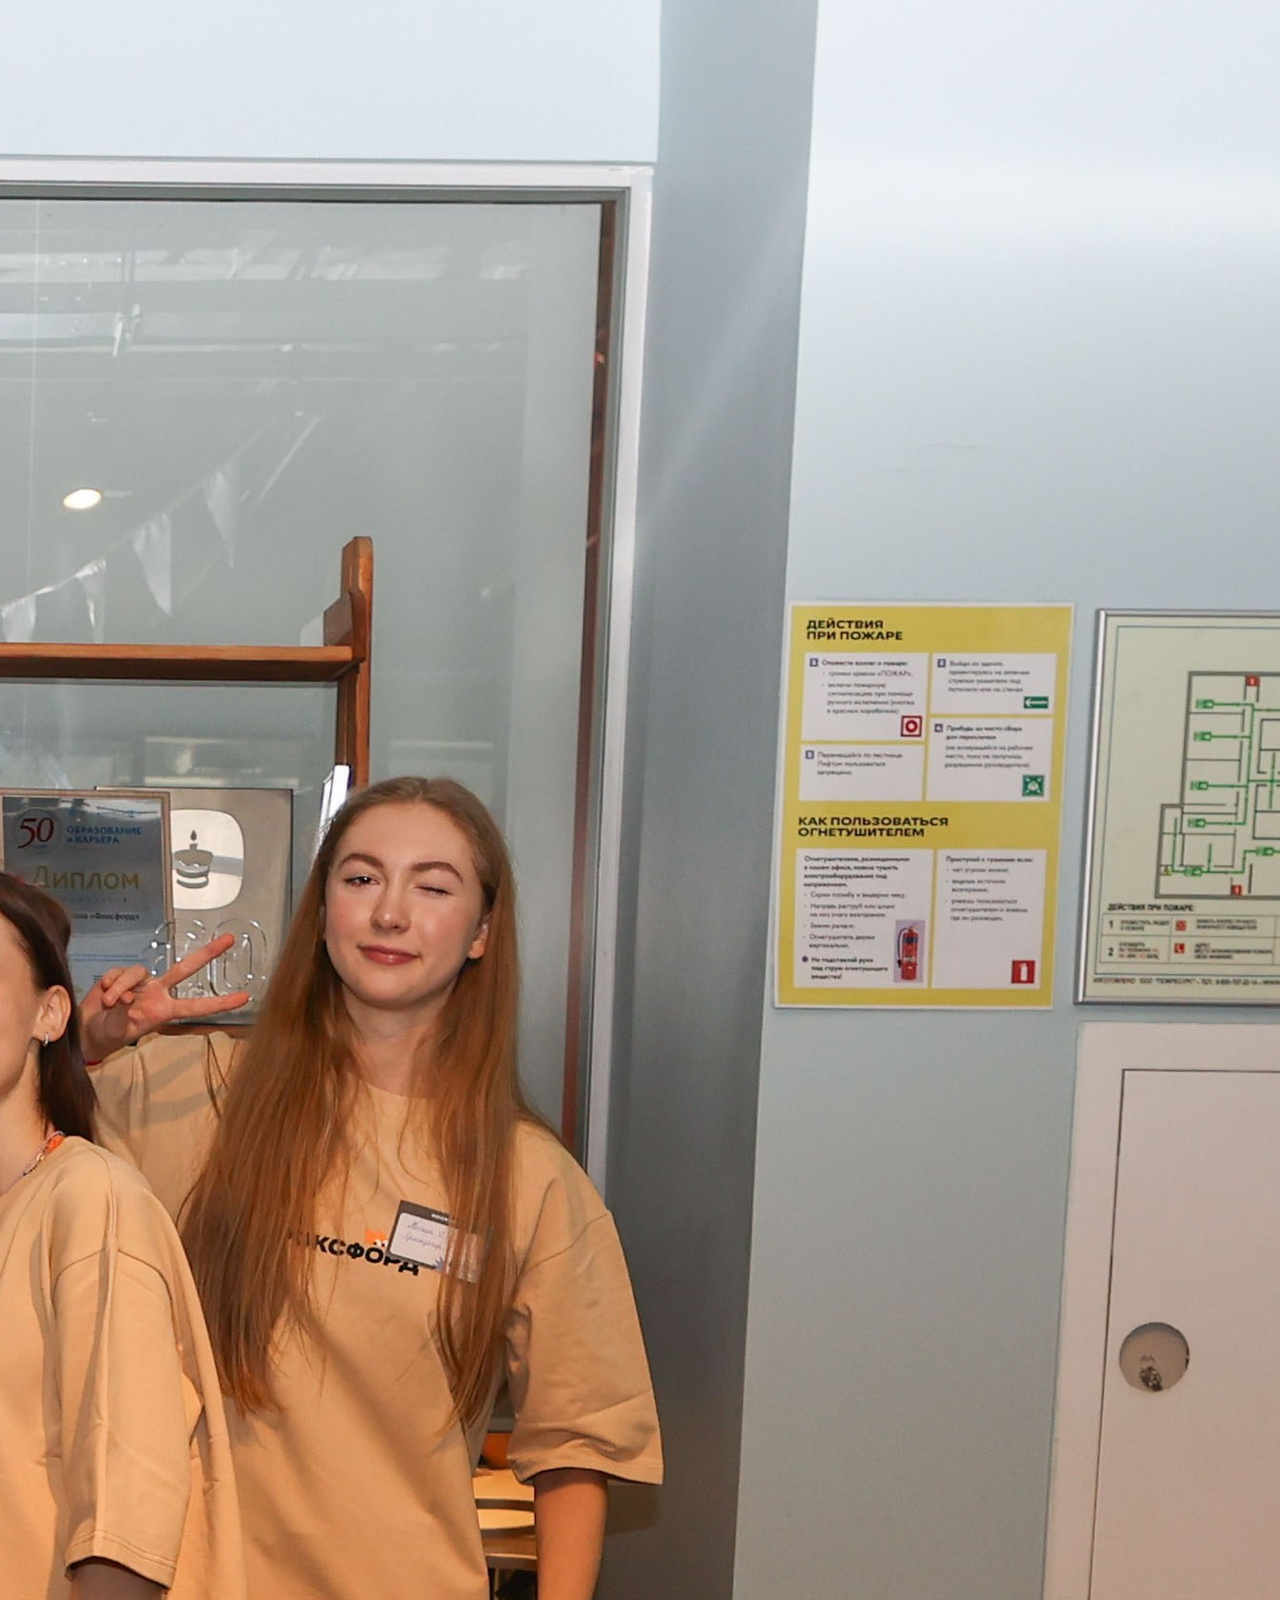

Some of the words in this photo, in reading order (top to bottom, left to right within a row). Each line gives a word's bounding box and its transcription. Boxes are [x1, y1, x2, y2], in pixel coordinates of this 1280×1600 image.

[806, 617, 884, 630] ДЕЙСТВИЯ
[806, 631, 836, 640] ПРИ
[840, 631, 903, 641] ПОЖАРЕ
[798, 817, 827, 826] КАК
[830, 817, 949, 826] ПОЛЬЗОВАТЬСЯ
[17, 817, 55, 849] 50
[66, 825, 143, 836] ОБРАЗОВАНИЕ
[798, 827, 925, 837] ОГНЕТУШИТЕЛЕМ
[74, 835, 120, 845] КАРЬЕРА
[33, 865, 140, 891] Диплом
